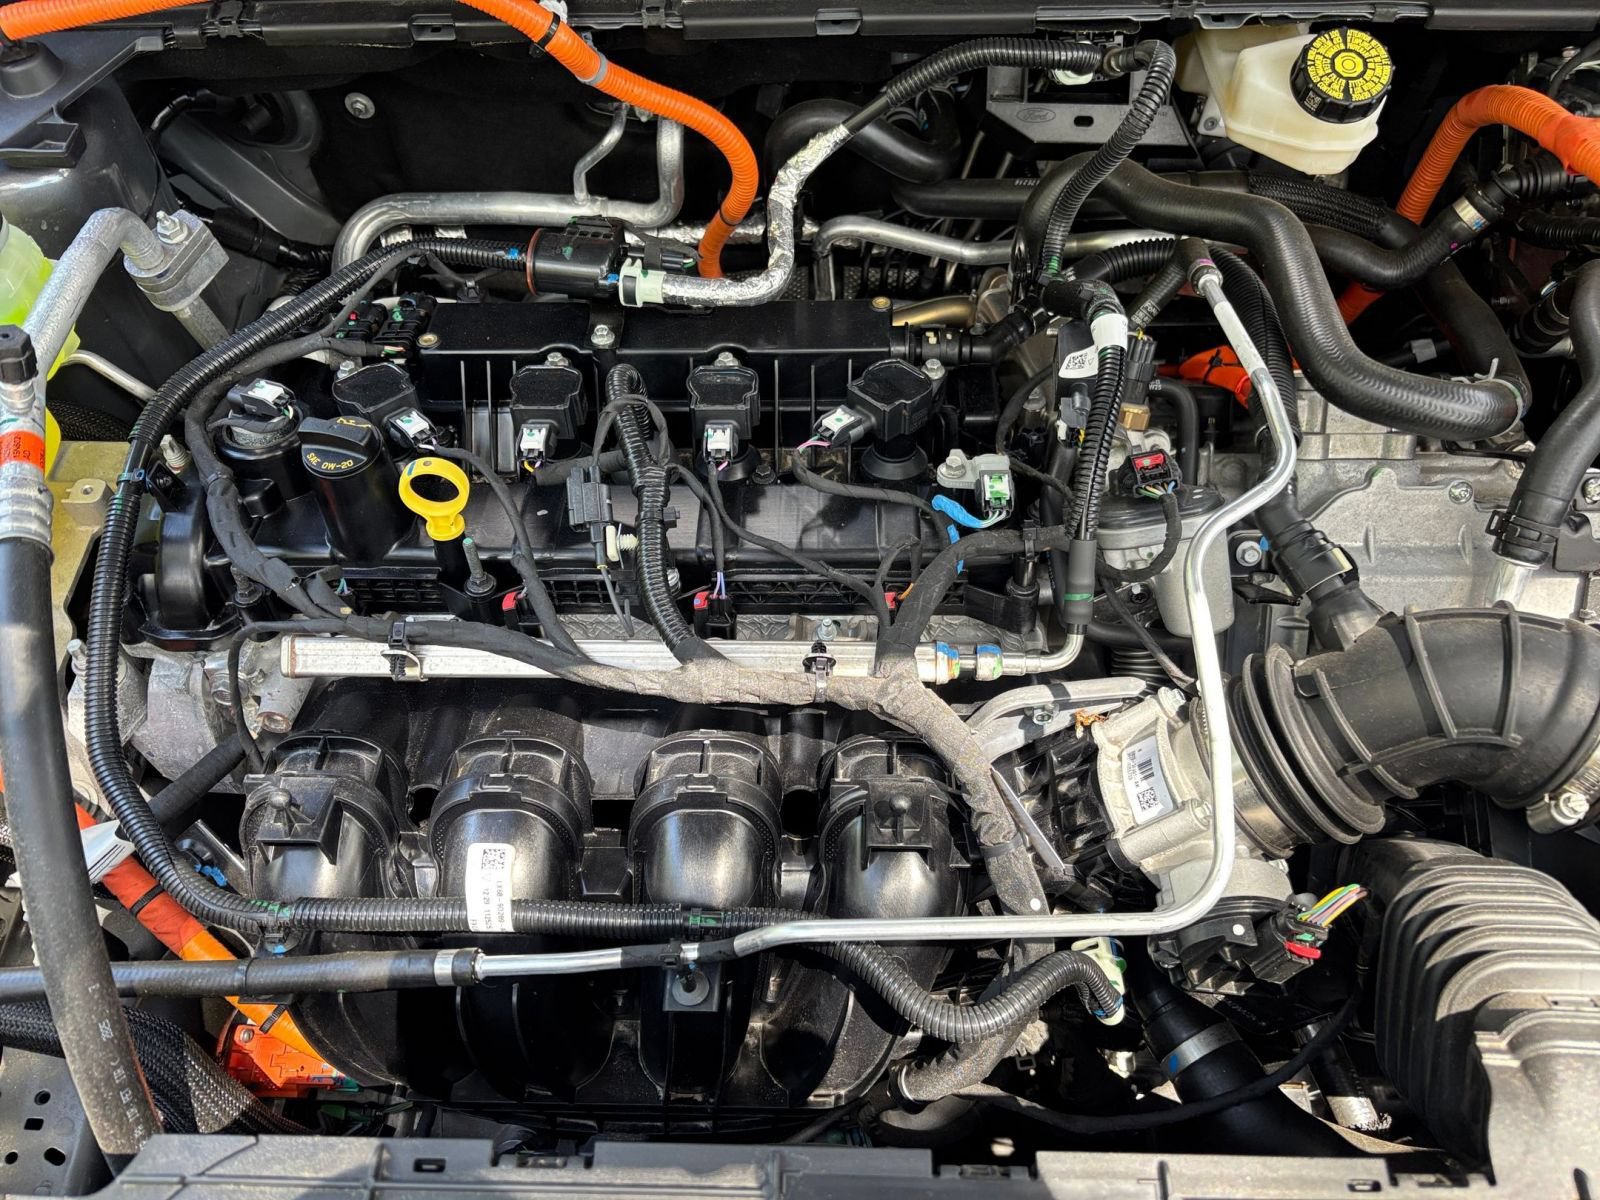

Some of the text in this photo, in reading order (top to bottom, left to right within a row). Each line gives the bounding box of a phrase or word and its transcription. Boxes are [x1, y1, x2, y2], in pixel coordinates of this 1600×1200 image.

[1019, 108, 1052, 122] Ford
[306, 452, 354, 470] SAE 0W-20
